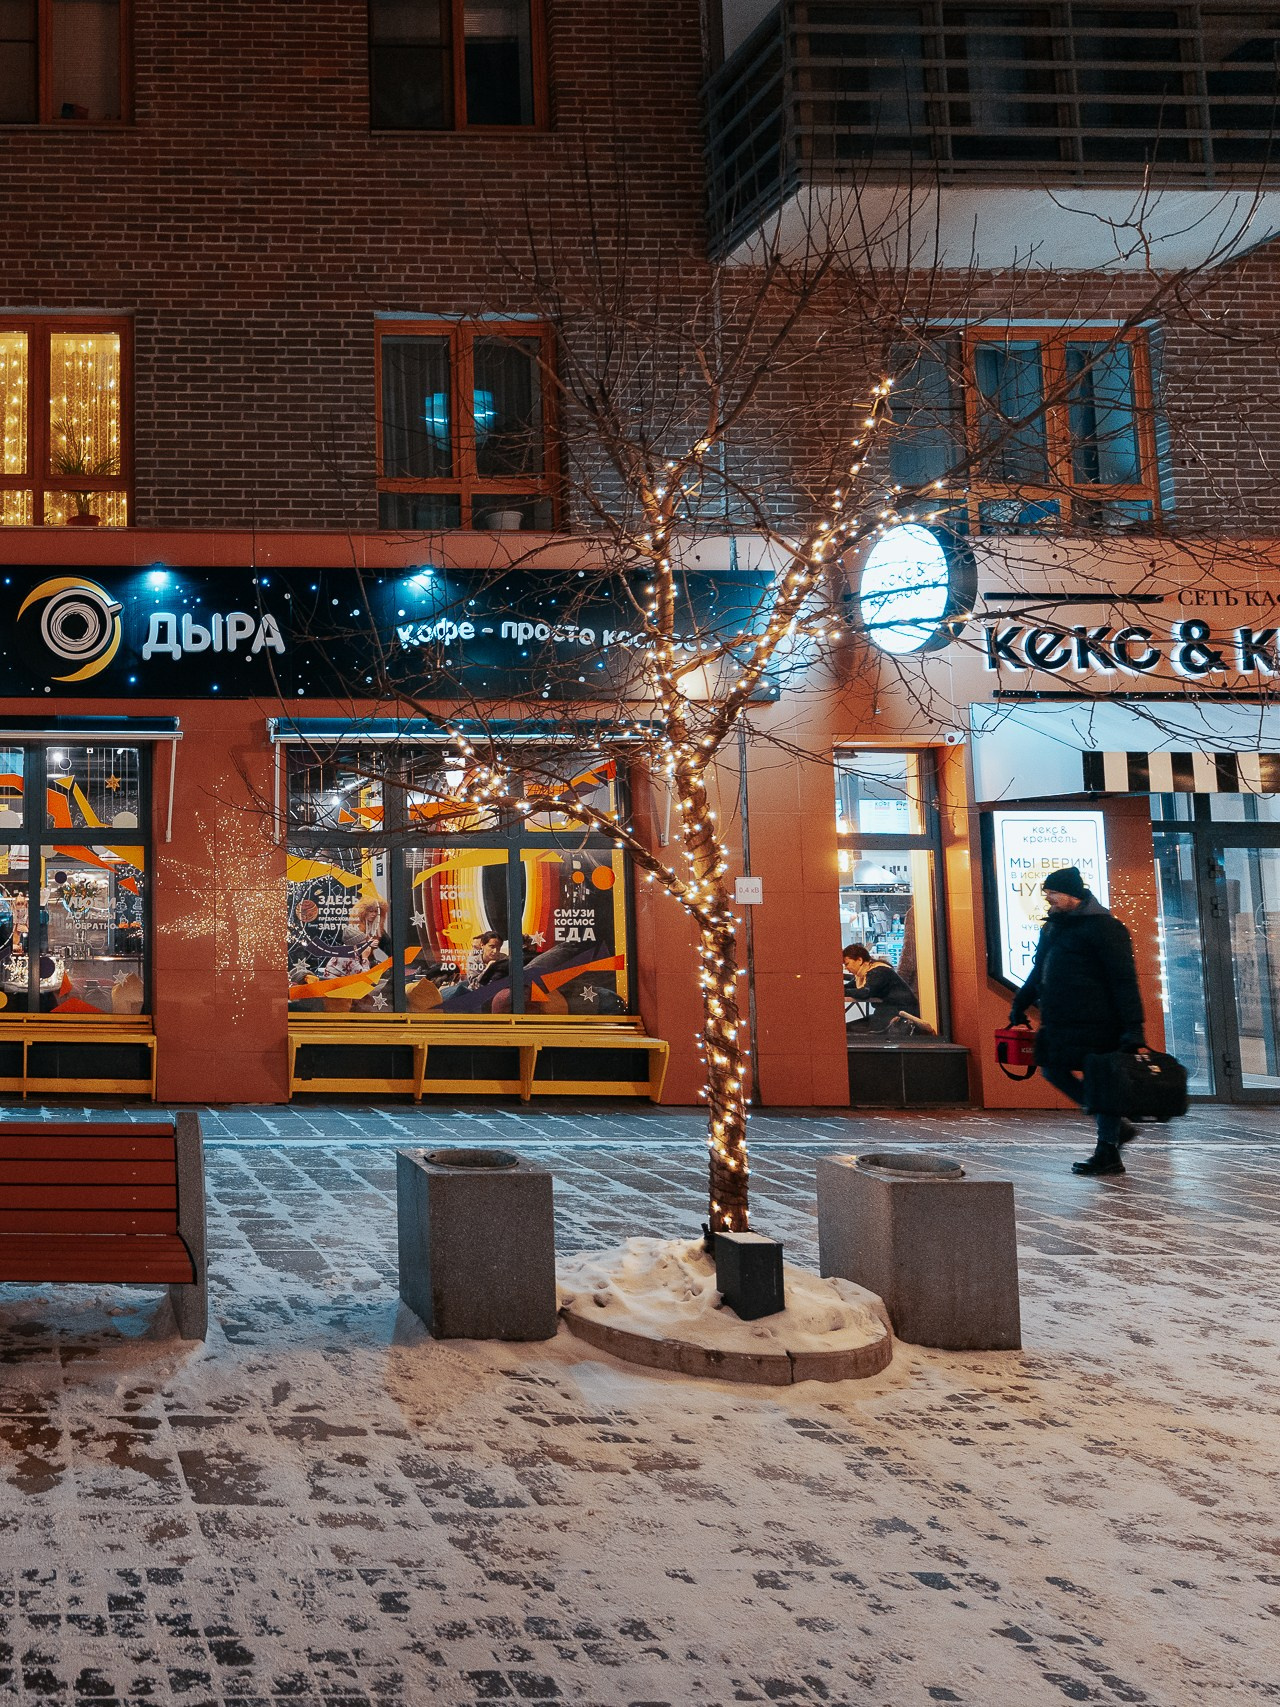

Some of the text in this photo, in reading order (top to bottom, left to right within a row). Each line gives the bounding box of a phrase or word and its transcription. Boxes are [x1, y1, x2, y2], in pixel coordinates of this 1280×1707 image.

[1177, 590, 1280, 606] СЕТЬ КА
[142, 612, 287, 661] ДЫРА
[1179, 618, 1231, 674] &
[1239, 627, 1280, 671] к
[1010, 857, 1094, 868] МЫ ВЕРИМ
[318, 895, 359, 906] ЗДЕСЬ
[554, 909, 595, 918] СМУЗИ
[75, 922, 117, 930] ОБРАТНО
[554, 918, 596, 926] КОСМОС
[554, 927, 597, 943] ЕДА
[440, 963, 456, 972] ДО
